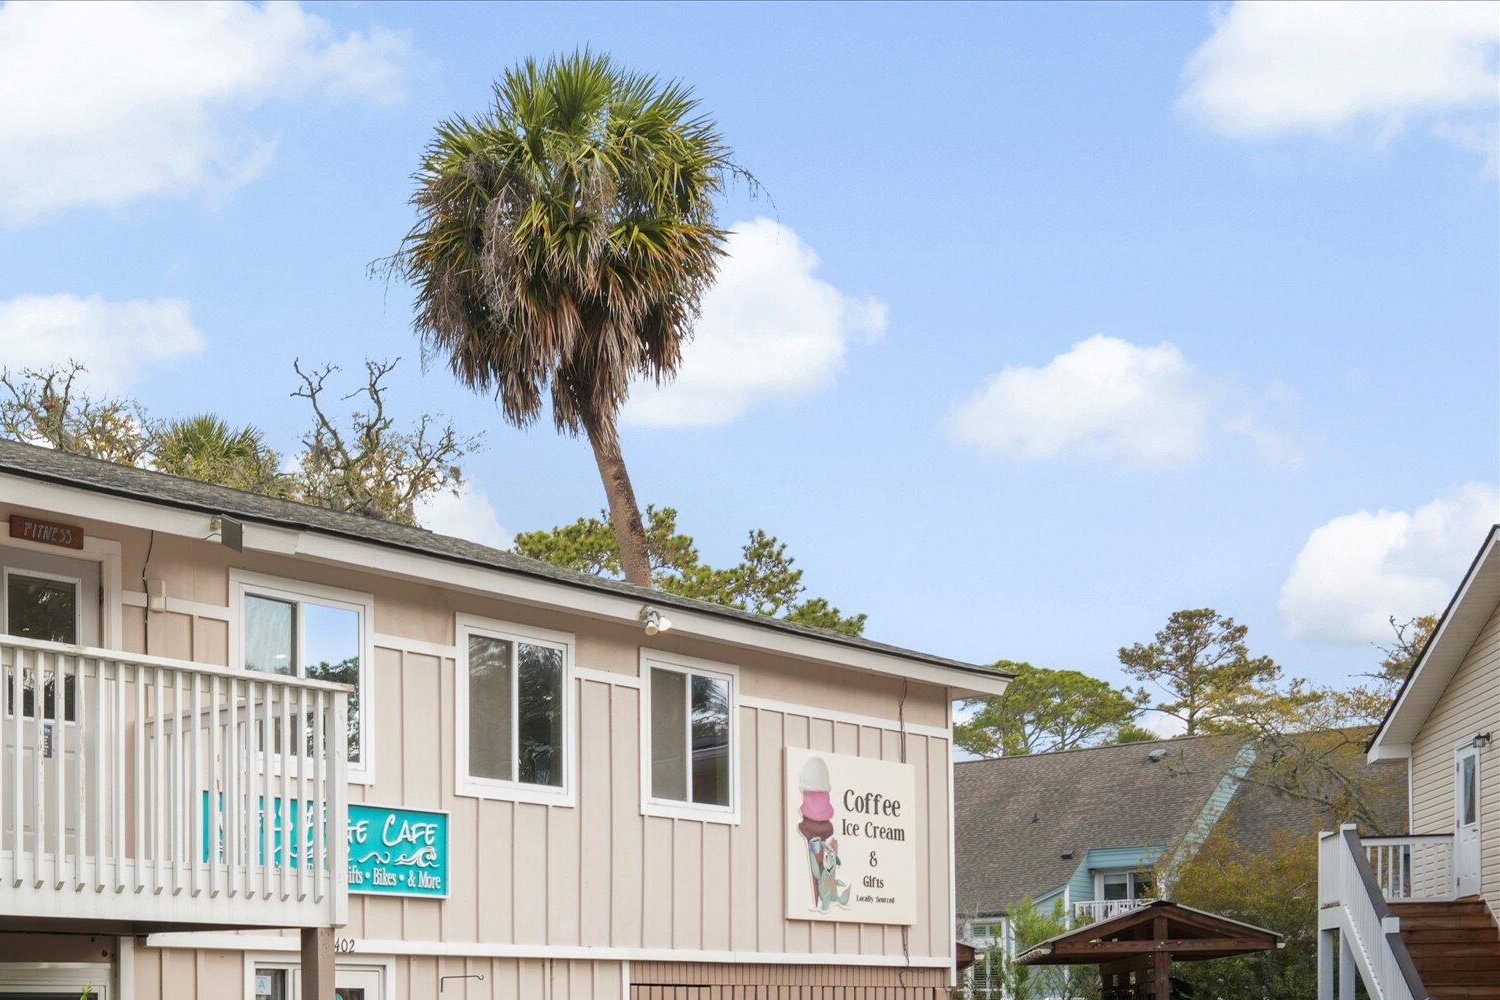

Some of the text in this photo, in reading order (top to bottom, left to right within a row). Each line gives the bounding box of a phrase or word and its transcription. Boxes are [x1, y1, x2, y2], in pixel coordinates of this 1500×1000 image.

[843, 789, 901, 817] Coffee
[382, 814, 438, 846] CAFE
[842, 819, 905, 841] Ice Cream
[869, 851, 878, 868] &
[347, 865, 441, 890] ifts Bikes & More
[863, 875, 884, 889] Gifts
[856, 894, 895, 904] Locally Sourced
